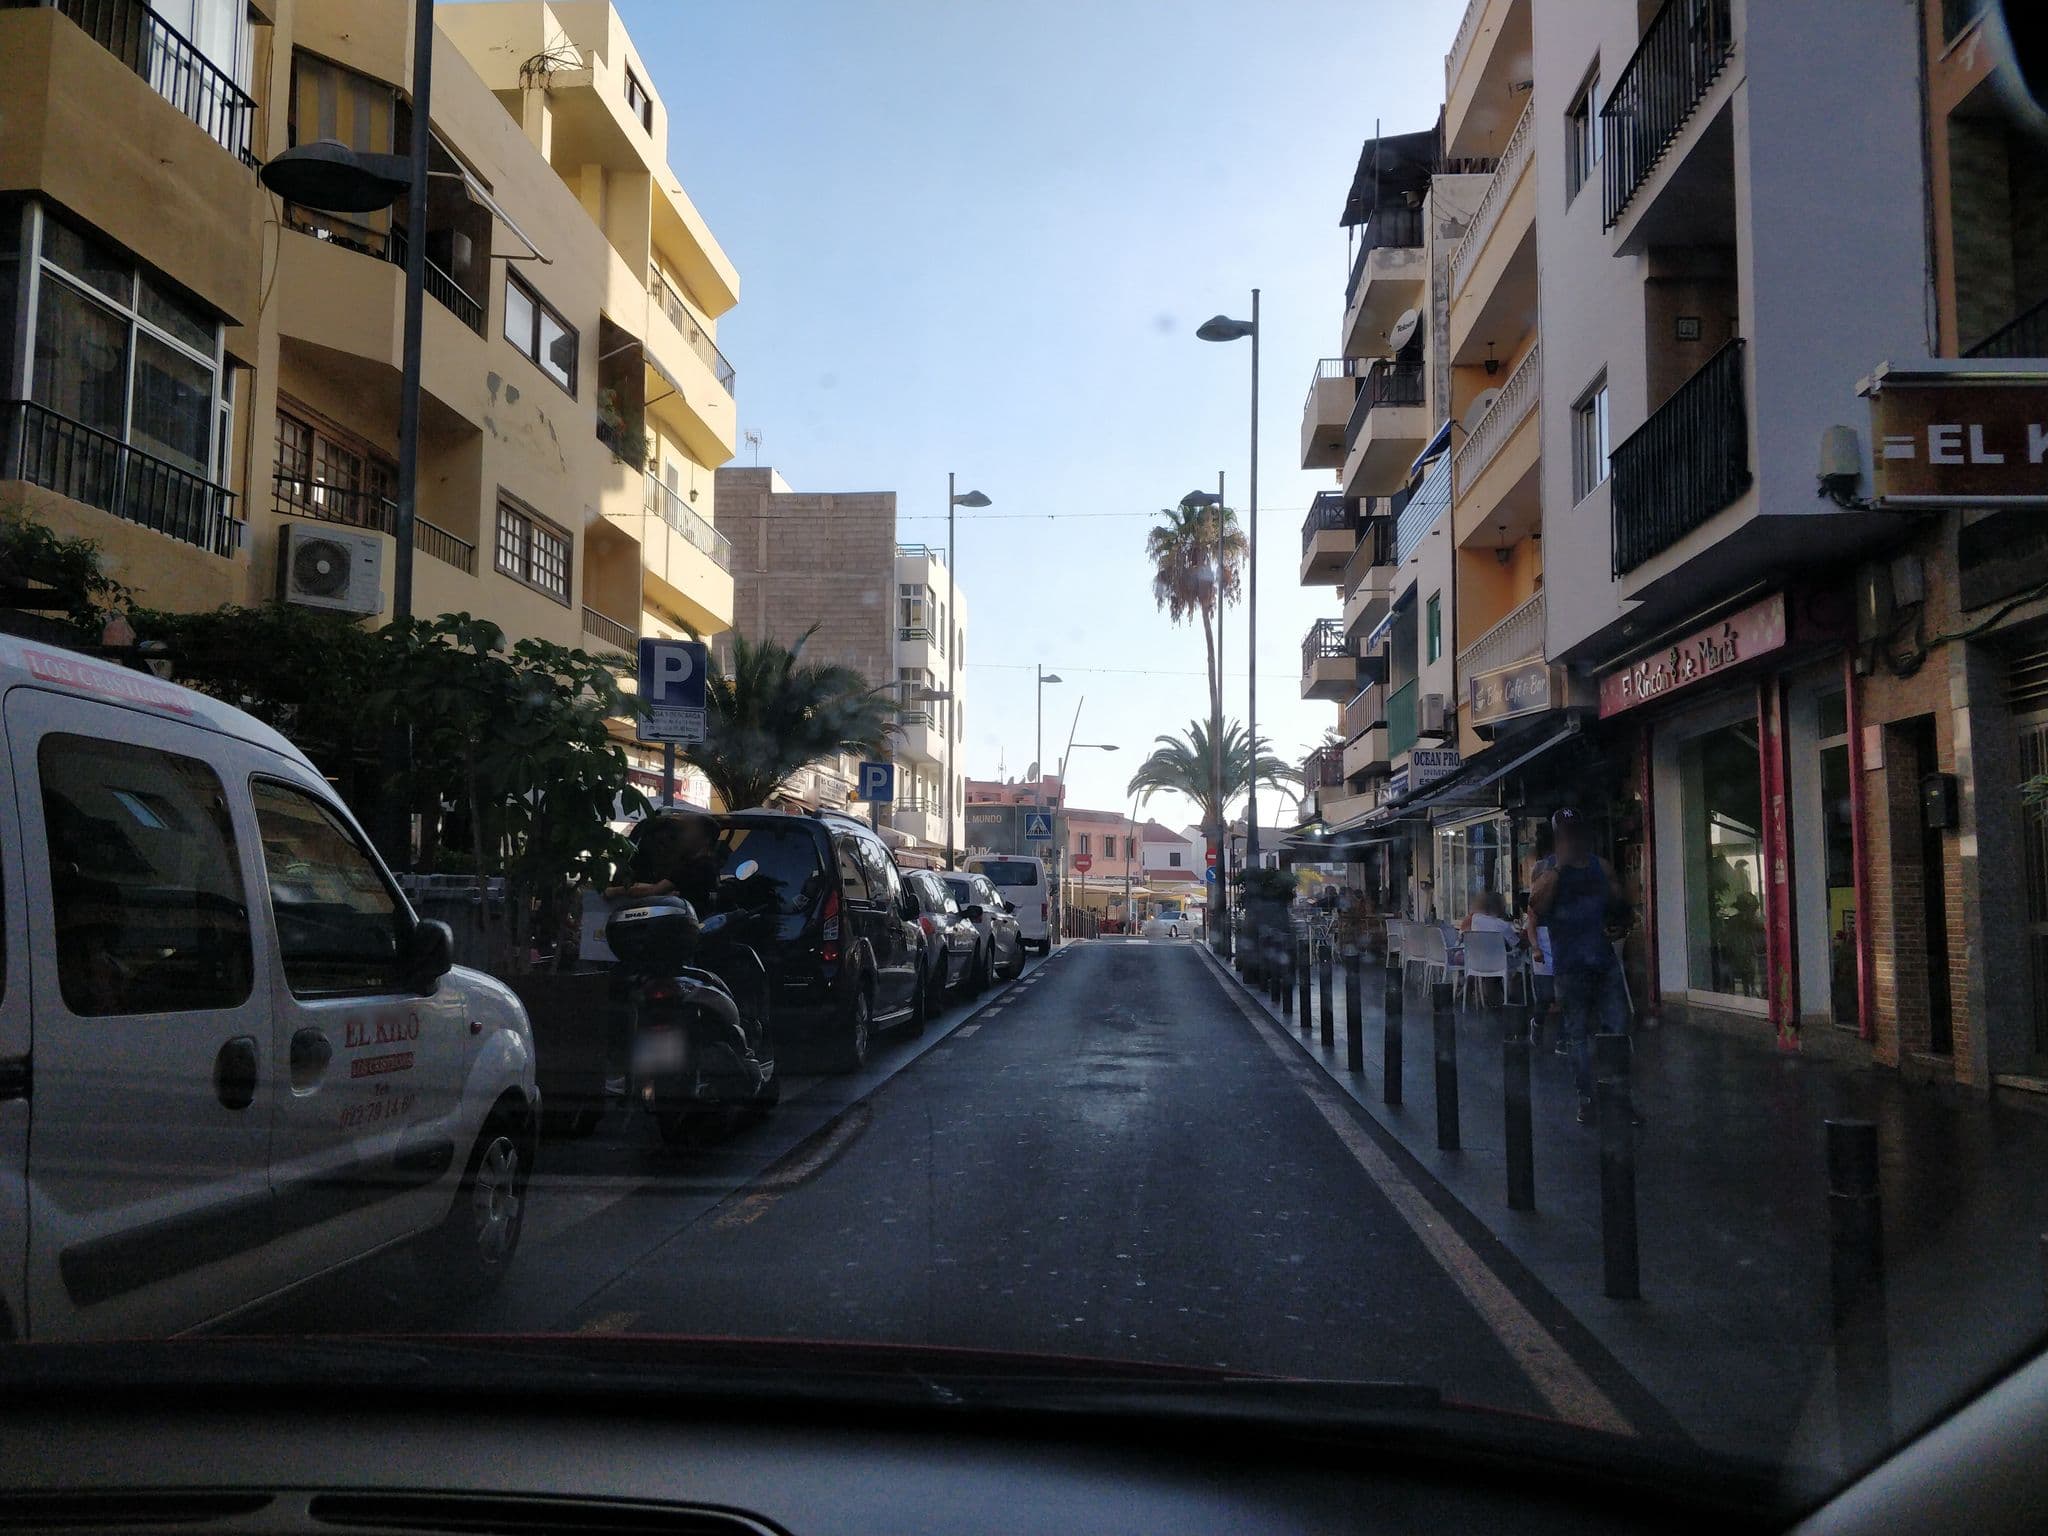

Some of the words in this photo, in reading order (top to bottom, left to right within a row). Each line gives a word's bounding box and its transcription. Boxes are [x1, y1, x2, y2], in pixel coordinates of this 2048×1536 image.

[1928, 424, 2005, 464] EL
[28, 655, 74, 681] LOS
[654, 646, 693, 699] P
[1622, 667, 1633, 698] El
[1636, 662, 1669, 698] Rincón
[1698, 622, 1738, 674] María
[1414, 751, 1441, 766] OCEAN
[867, 766, 887, 797] P
[972, 814, 1002, 824] MUNDO
